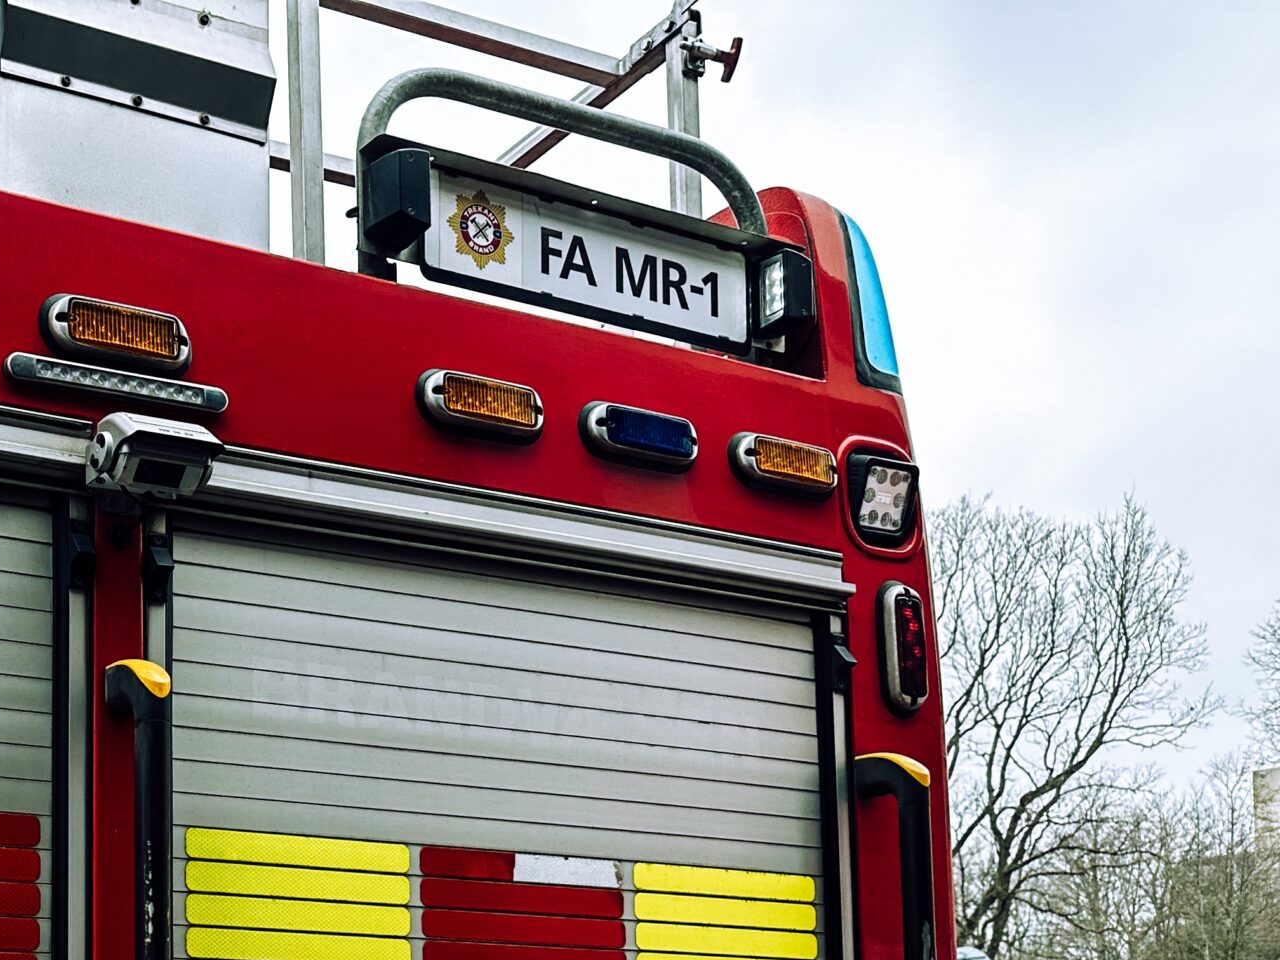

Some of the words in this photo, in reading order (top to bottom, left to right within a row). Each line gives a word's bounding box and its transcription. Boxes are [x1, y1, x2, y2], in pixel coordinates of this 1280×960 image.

[464, 205, 498, 225] TREKANT
[468, 240, 494, 253] BRAND
[540, 226, 597, 287] FA
[615, 246, 719, 318] MR-1
